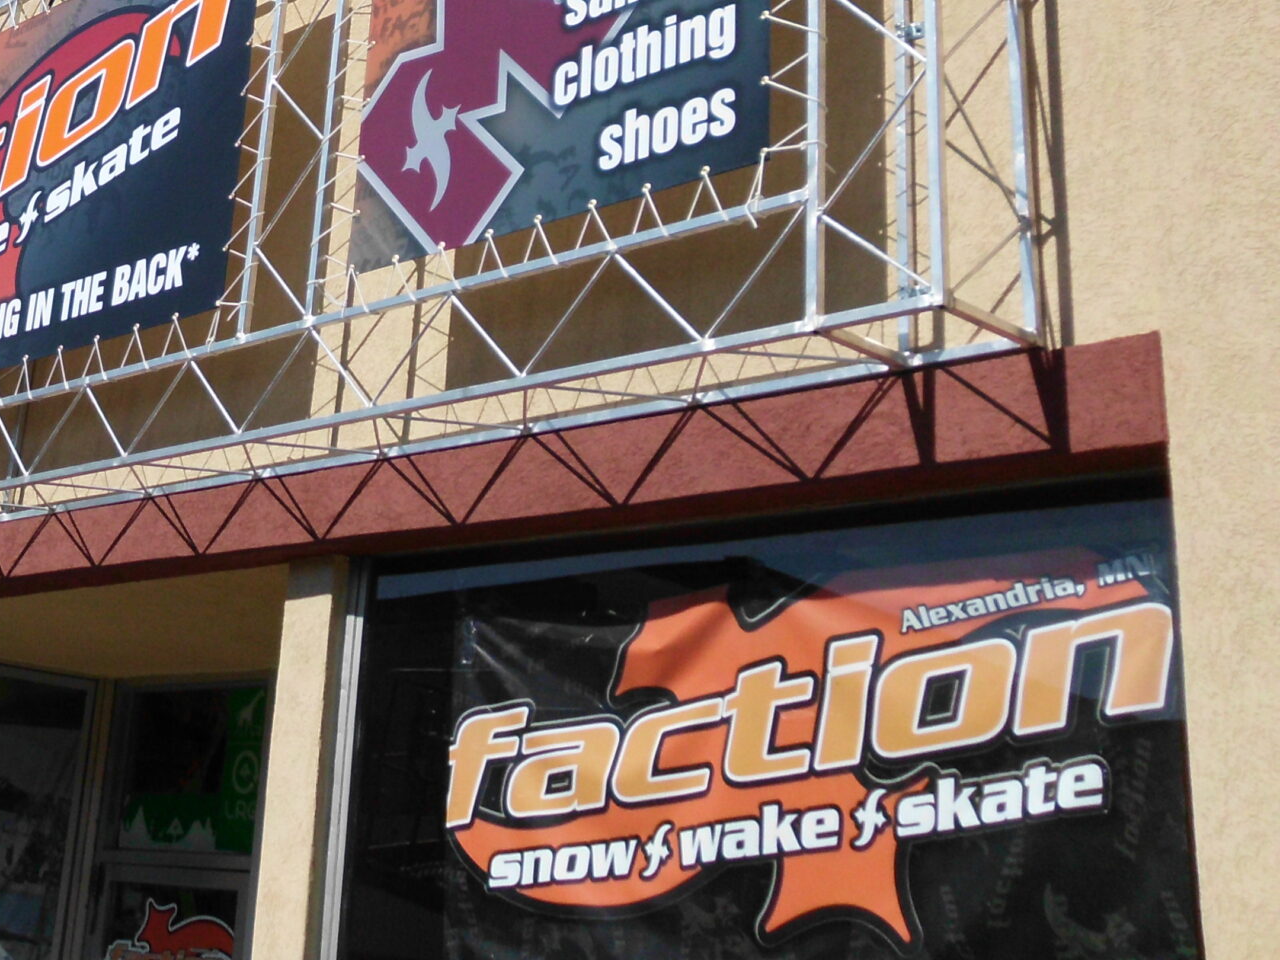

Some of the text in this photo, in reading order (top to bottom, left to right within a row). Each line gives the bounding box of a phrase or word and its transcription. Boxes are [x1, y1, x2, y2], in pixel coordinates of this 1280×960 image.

[553, 2, 737, 108] clothing
[45, 107, 181, 221] skate
[598, 86, 736, 172] shoes
[25, 284, 54, 331] IN
[61, 270, 108, 320] THE
[900, 554, 1151, 633] Alexandria, MN
[446, 601, 1174, 829] faction
[488, 762, 1104, 889] snow wake skate
